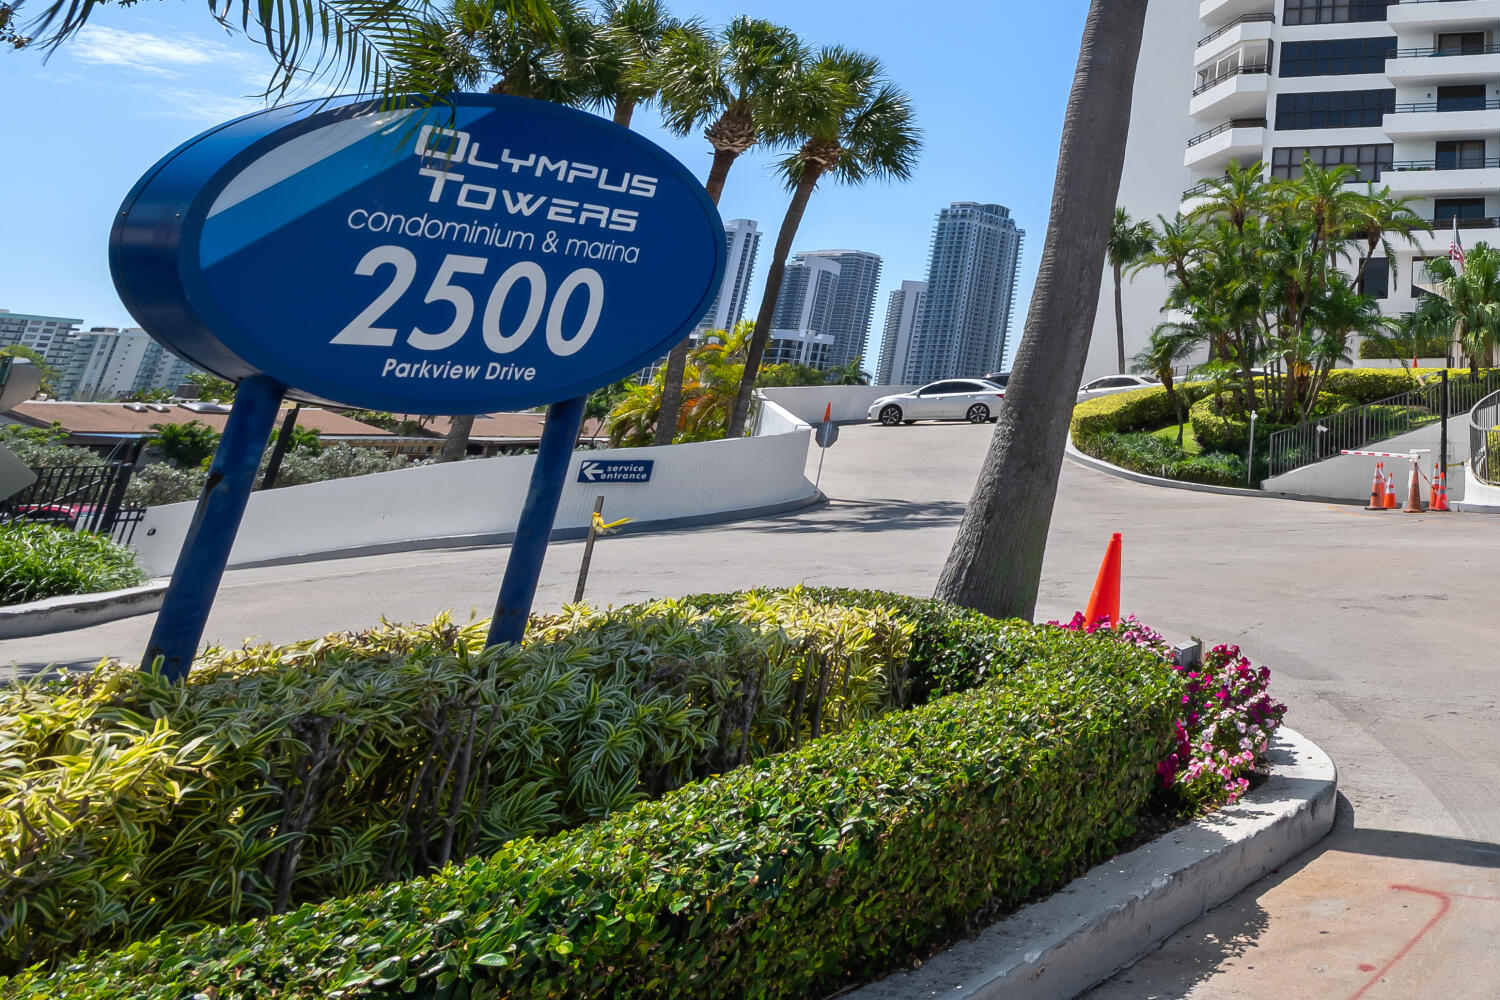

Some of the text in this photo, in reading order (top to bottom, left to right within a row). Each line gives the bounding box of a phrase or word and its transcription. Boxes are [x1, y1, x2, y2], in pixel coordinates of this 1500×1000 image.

[415, 125, 658, 198] OLYMPUS
[419, 168, 639, 232] TOWERS
[347, 209, 640, 263] condominium & marina
[329, 245, 604, 356] 2500
[381, 358, 536, 381] Parkview Drive
[600, 472, 647, 480] entrance
[607, 464, 644, 472] service
